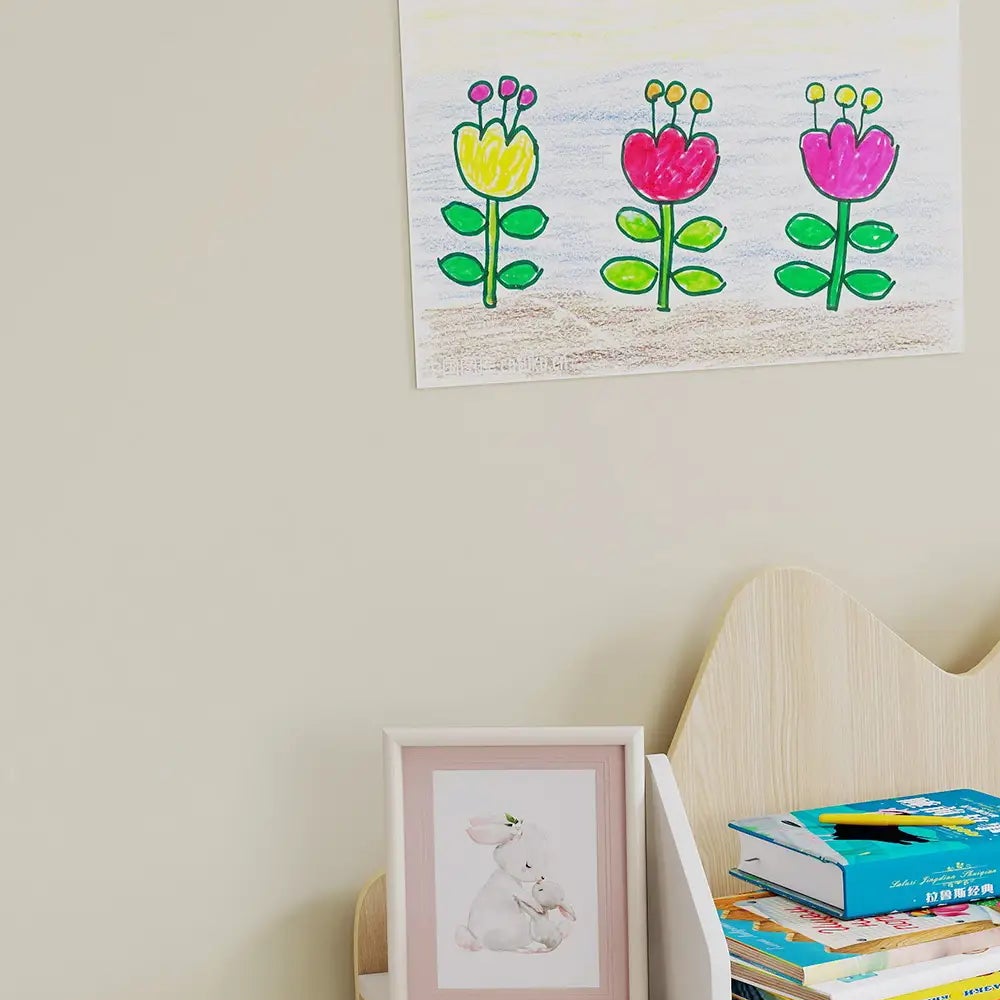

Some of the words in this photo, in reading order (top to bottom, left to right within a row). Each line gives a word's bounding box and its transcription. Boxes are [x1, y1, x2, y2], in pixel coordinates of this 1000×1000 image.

[925, 883, 994, 903] 拉鲁斯经典
